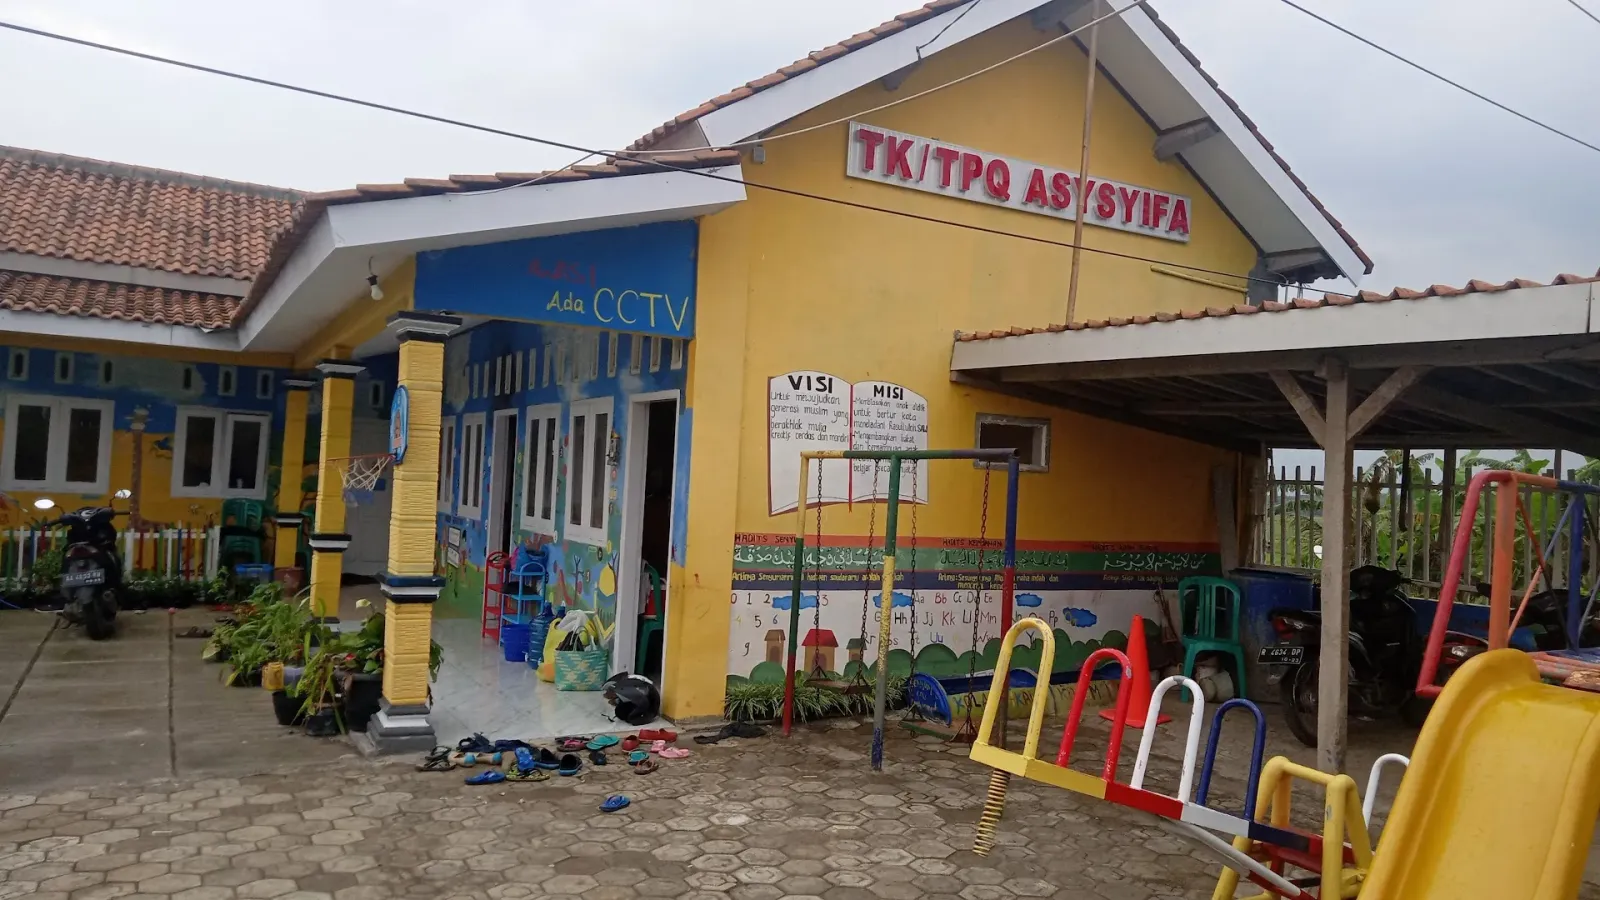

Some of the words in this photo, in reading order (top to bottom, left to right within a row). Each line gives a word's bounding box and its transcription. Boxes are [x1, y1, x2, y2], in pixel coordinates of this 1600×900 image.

[857, 128, 1011, 201] TK/TPQ
[1022, 168, 1190, 235] ASYSYIFA
[546, 290, 585, 314] Ada
[594, 288, 689, 332] CCTV
[788, 375, 833, 393] VISI
[873, 385, 904, 400] MISI
[804, 406, 829, 416] muslim
[735, 533, 768, 544] HADITS
[775, 535, 798, 544] SENYU
[763, 593, 771, 605] 2
[821, 594, 829, 607] 3
[935, 592, 948, 605] Bb
[754, 615, 763, 628] 5
[772, 614, 779, 625] 6
[894, 611, 908, 625] Hh
[922, 611, 934, 627] Jj
[941, 610, 956, 627] Kk
[979, 611, 997, 625] Mm
[930, 631, 944, 644] Uu
